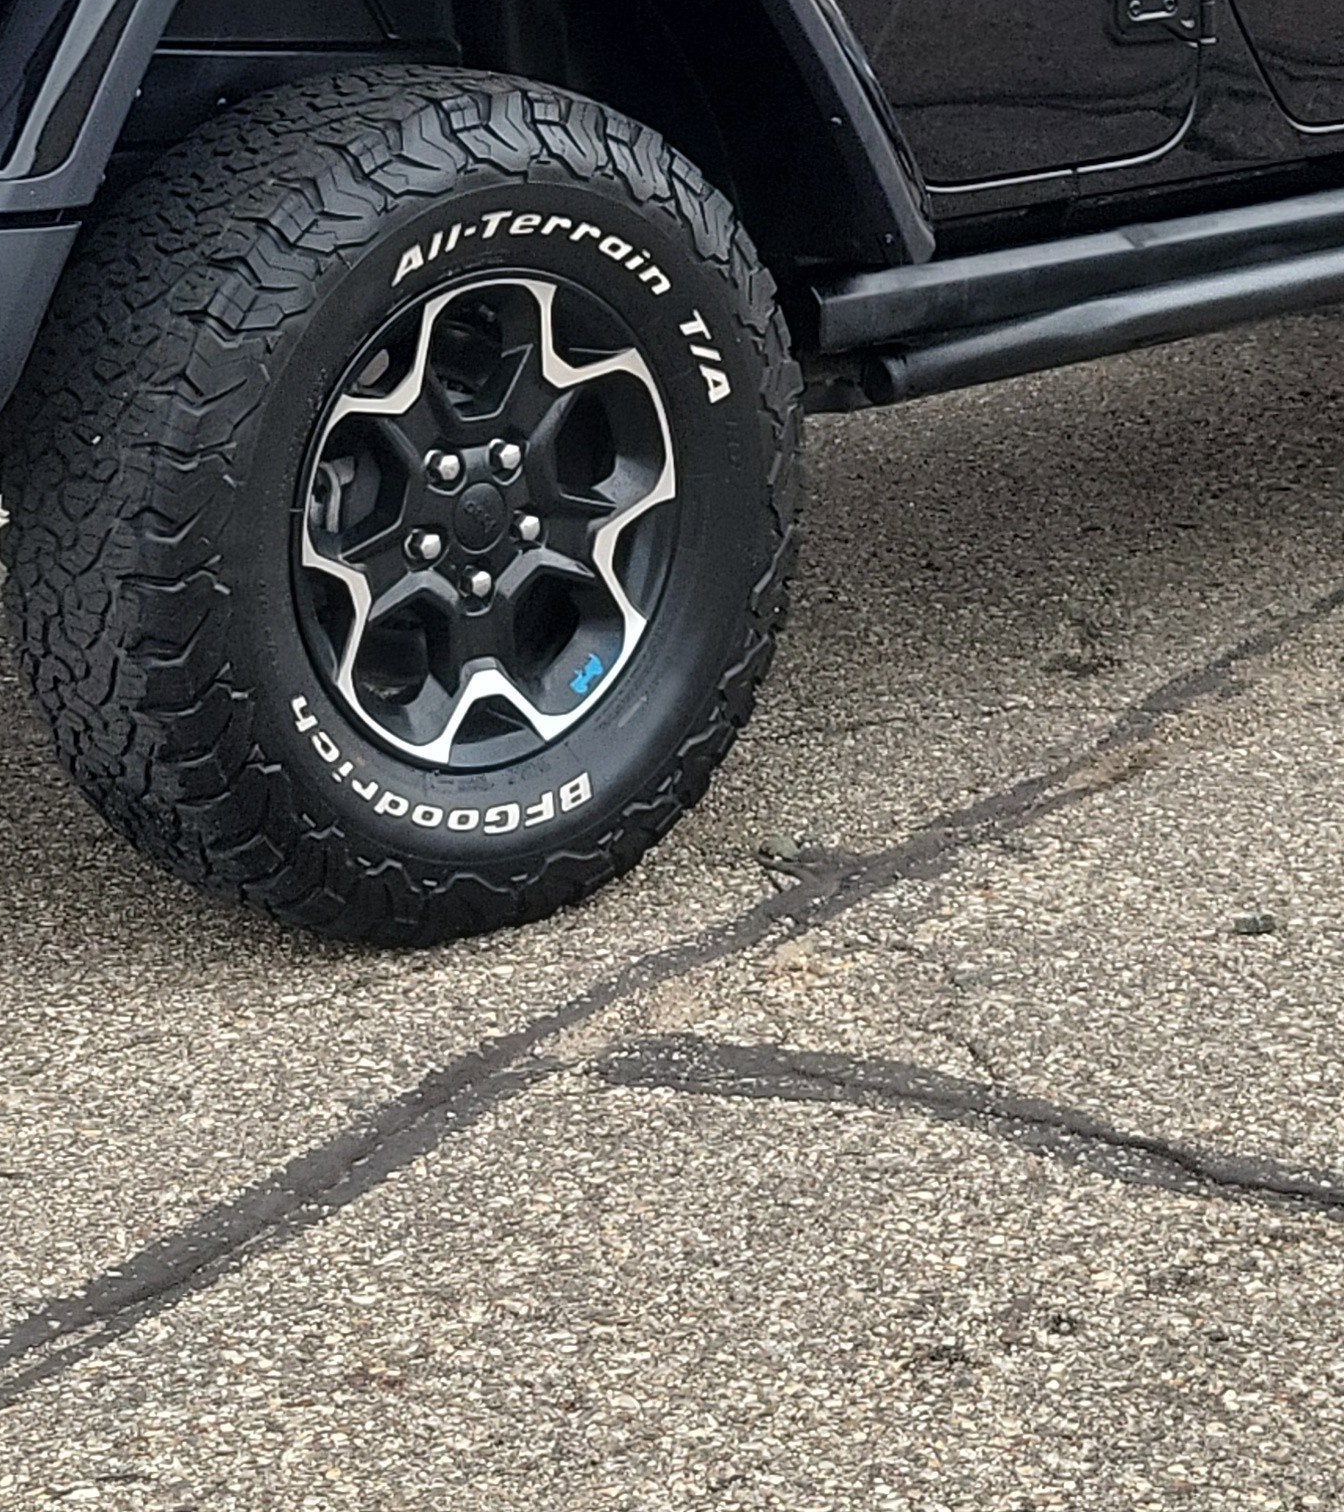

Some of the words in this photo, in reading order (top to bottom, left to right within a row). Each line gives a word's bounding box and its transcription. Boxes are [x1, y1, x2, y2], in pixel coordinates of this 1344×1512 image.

[390, 209, 673, 297] All-Terrain
[677, 309, 733, 406] T/A
[289, 694, 595, 835] BFGoodrich
